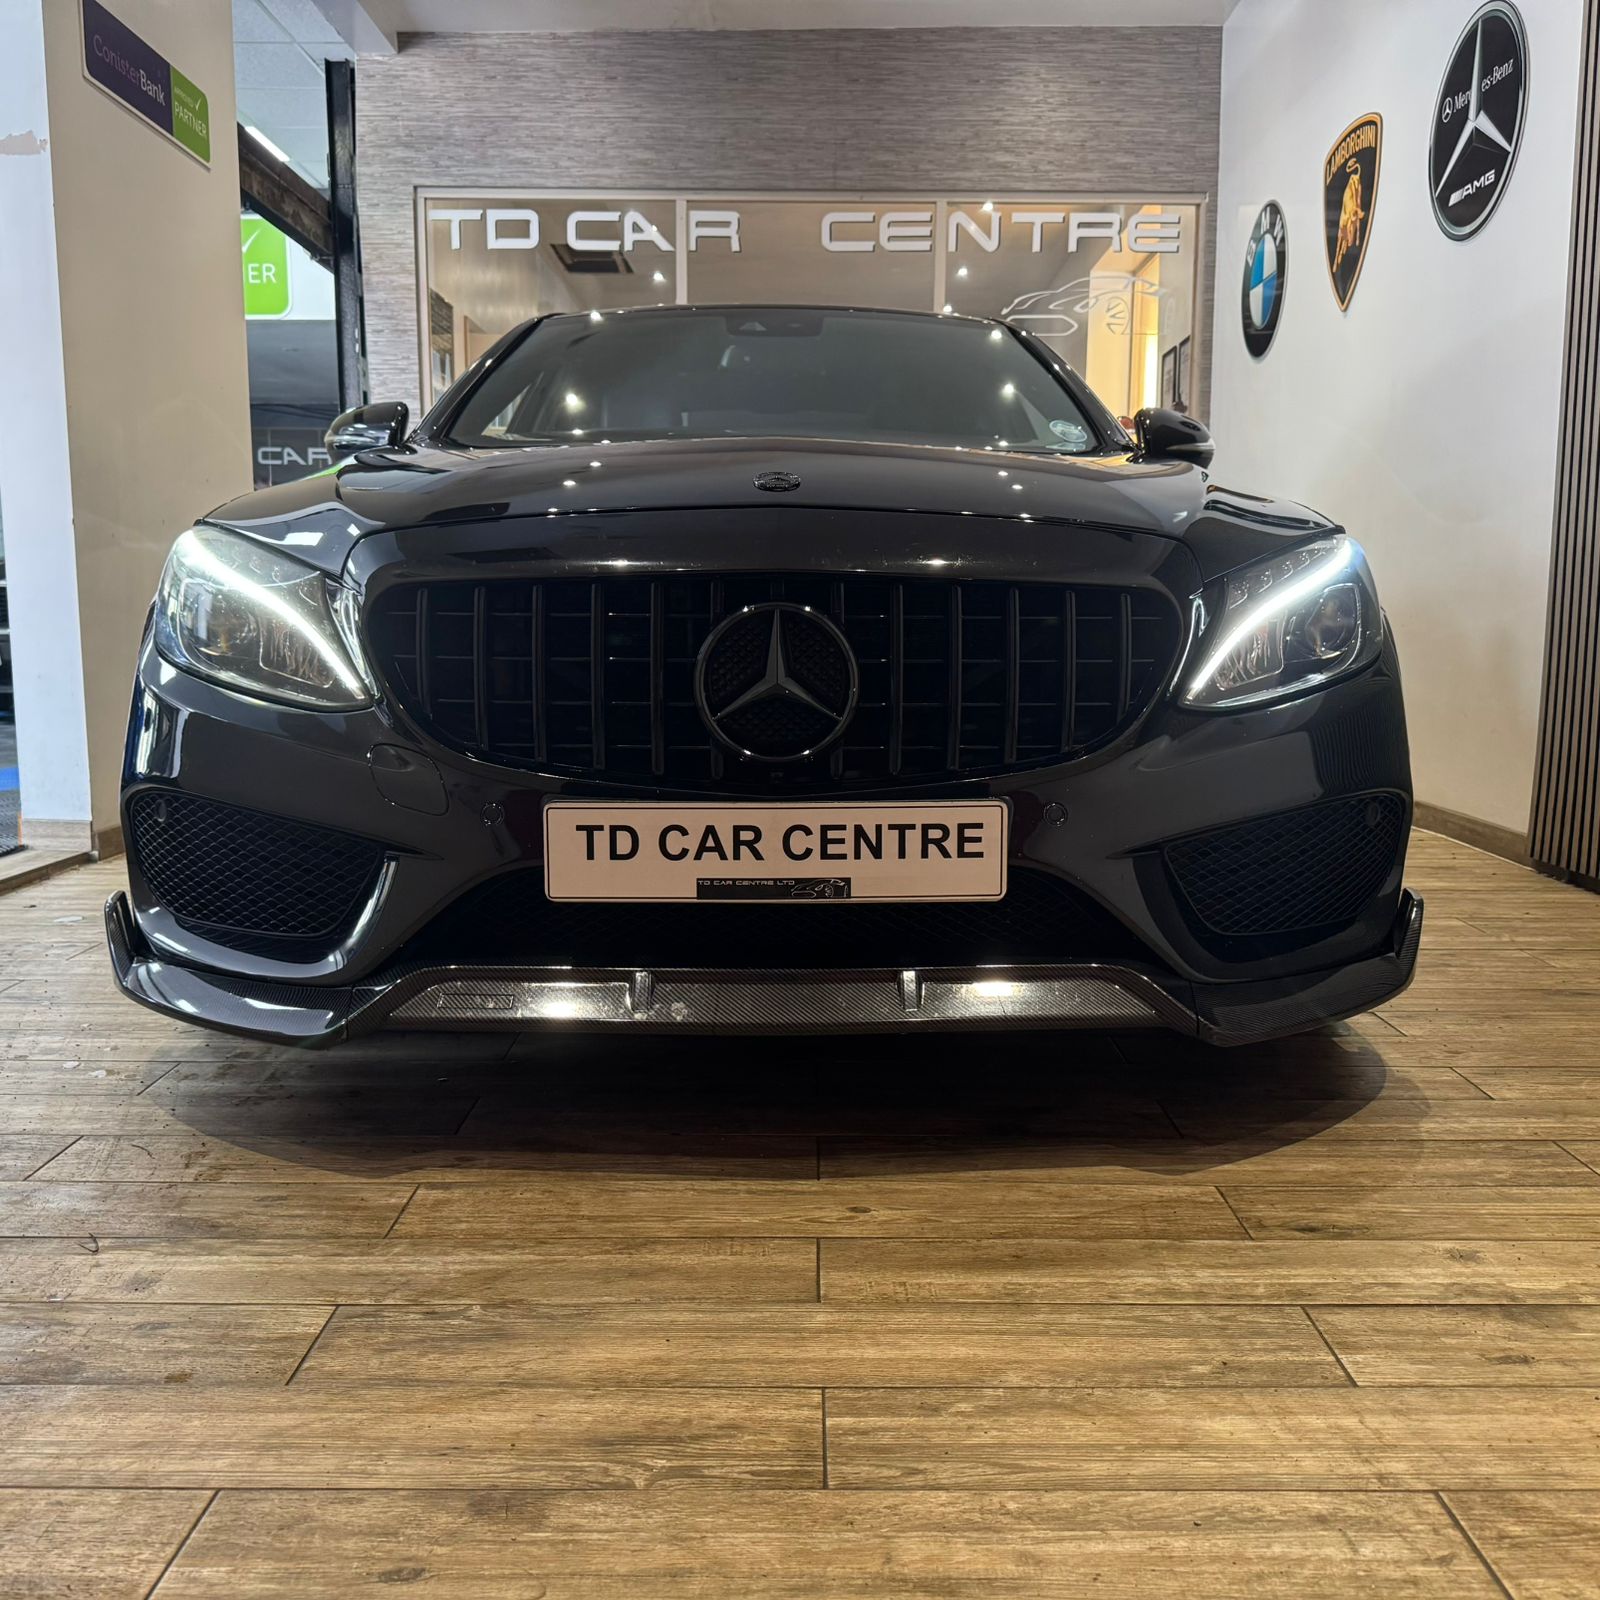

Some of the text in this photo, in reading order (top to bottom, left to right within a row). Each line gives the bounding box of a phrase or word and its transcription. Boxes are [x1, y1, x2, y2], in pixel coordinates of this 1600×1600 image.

[1453, 58, 1514, 113] Meres-Benz
[174, 102, 207, 139] PARTNER
[1326, 124, 1376, 186] LAMBORGHINI
[1461, 168, 1496, 199] AMG
[428, 208, 1182, 254] TD CAR CENTRE
[1246, 205, 1284, 268] BMW
[576, 822, 985, 862] TD CAR CENTRE
